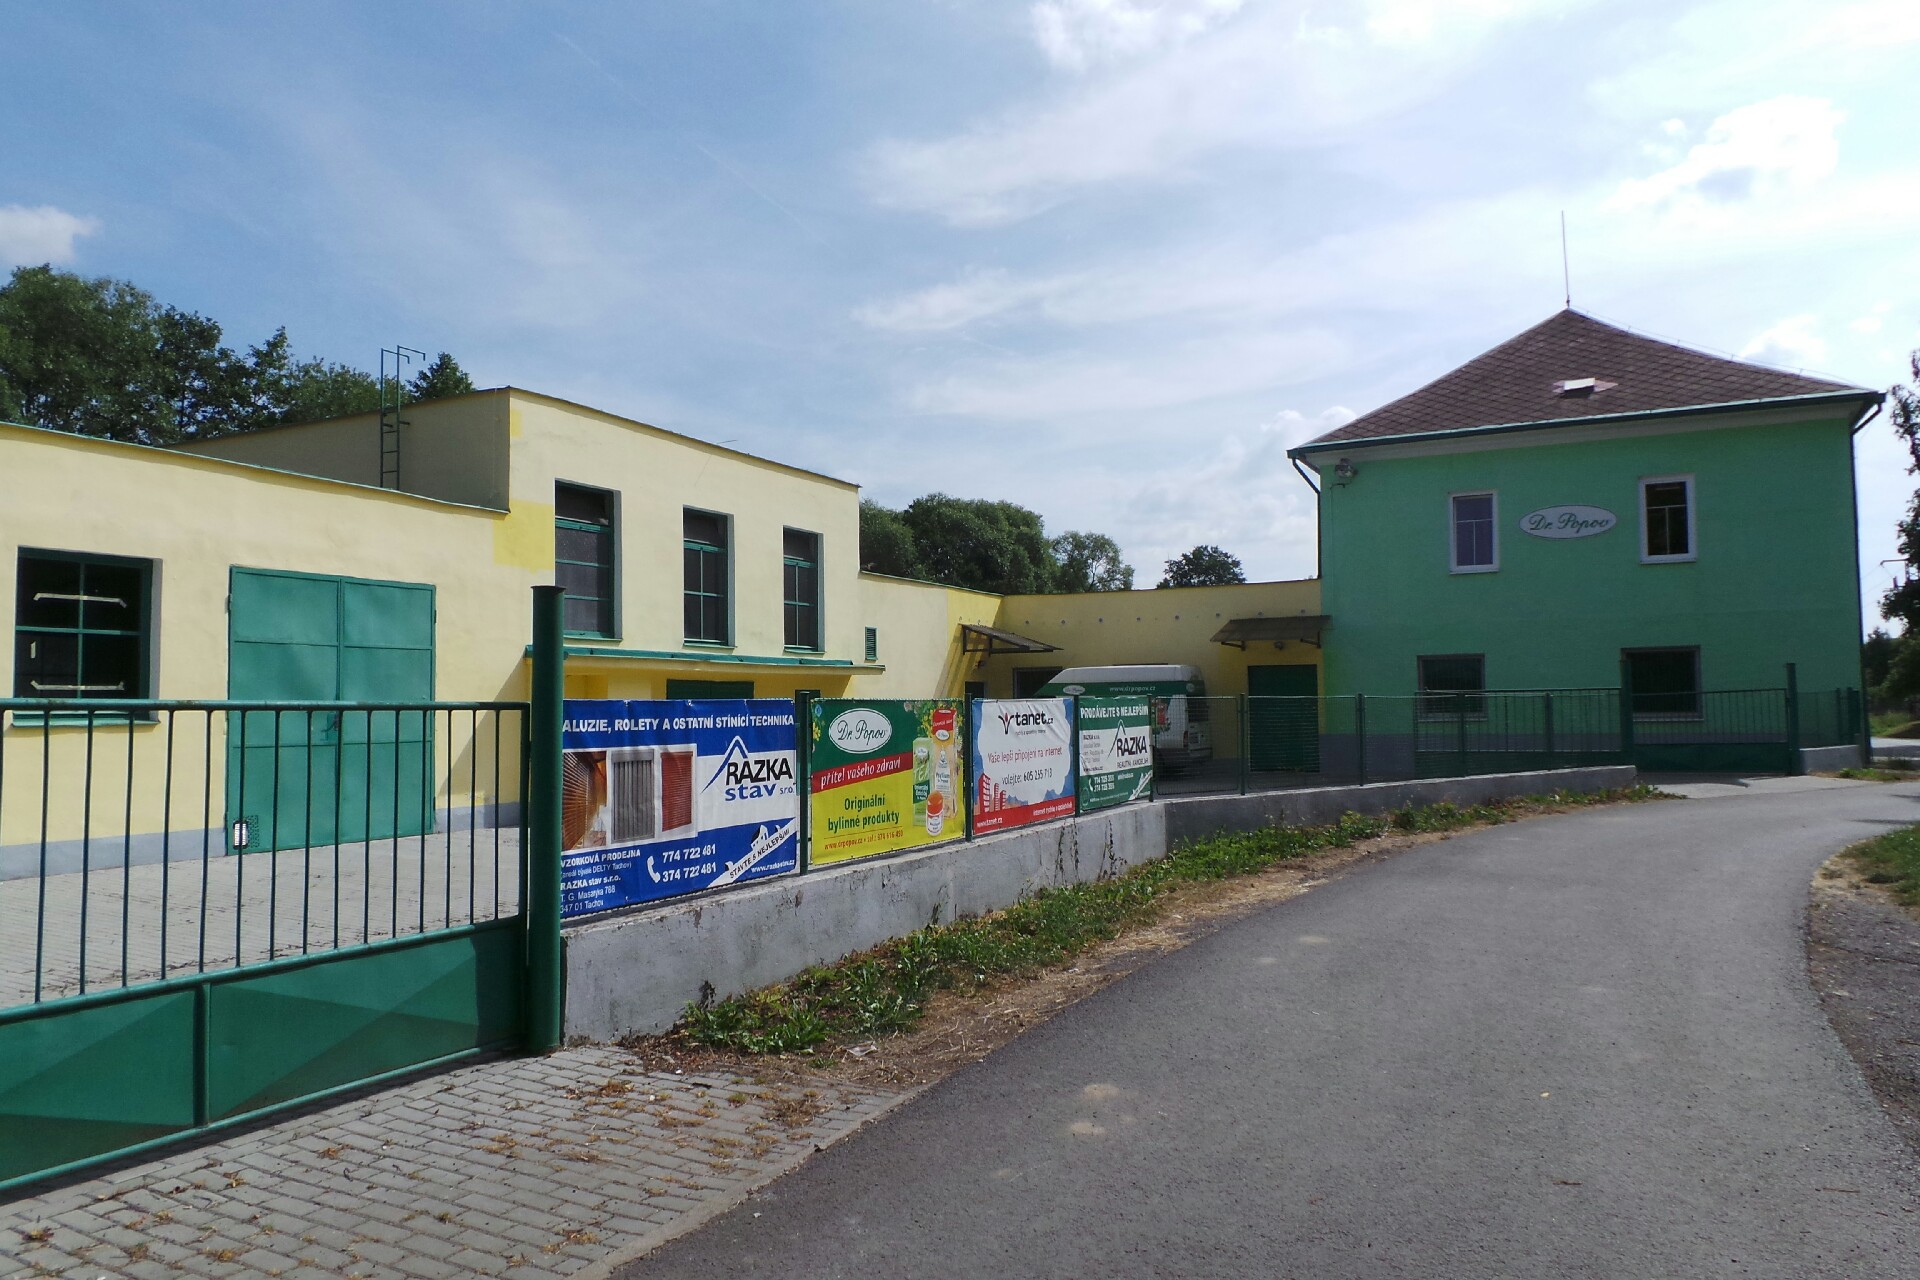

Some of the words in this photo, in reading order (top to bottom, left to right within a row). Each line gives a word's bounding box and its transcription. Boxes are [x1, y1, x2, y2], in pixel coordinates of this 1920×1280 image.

[1529, 514, 1552, 530] Dr.
[1557, 512, 1608, 534] Popov
[614, 719, 659, 731] ROLETY
[662, 719, 671, 730] A
[673, 715, 714, 730] OSTATNÍ
[716, 714, 749, 728] STÍNÍCÍ
[750, 715, 794, 727] TECHNIKA
[837, 719, 852, 741] Dr.
[855, 719, 887, 745] Popov
[1116, 735, 1148, 757] RAZKA
[726, 757, 793, 786] RAZKA
[820, 769, 845, 789] přítel
[847, 765, 875, 781] vašeho
[876, 757, 901, 773] zdraví
[725, 783, 777, 802] stav
[844, 794, 886, 812] Originální
[828, 814, 860, 834] bylinné
[862, 810, 900, 829] produkty
[561, 854, 600, 868] VZORKOVÁ
[601, 848, 641, 862] PRODEJNA
[663, 850, 680, 863] 774
[683, 847, 700, 860] 722
[702, 843, 716, 856] 481
[592, 862, 611, 874] DELTY
[663, 867, 680, 882] 374
[683, 865, 700, 879] 722
[701, 861, 717, 875] 481
[730, 858, 751, 878] STAVTE
[560, 878, 588, 891] RAZKA
[588, 876, 602, 886] stav
[603, 874, 622, 884] s.r.o.
[585, 898, 604, 909] Tachov
